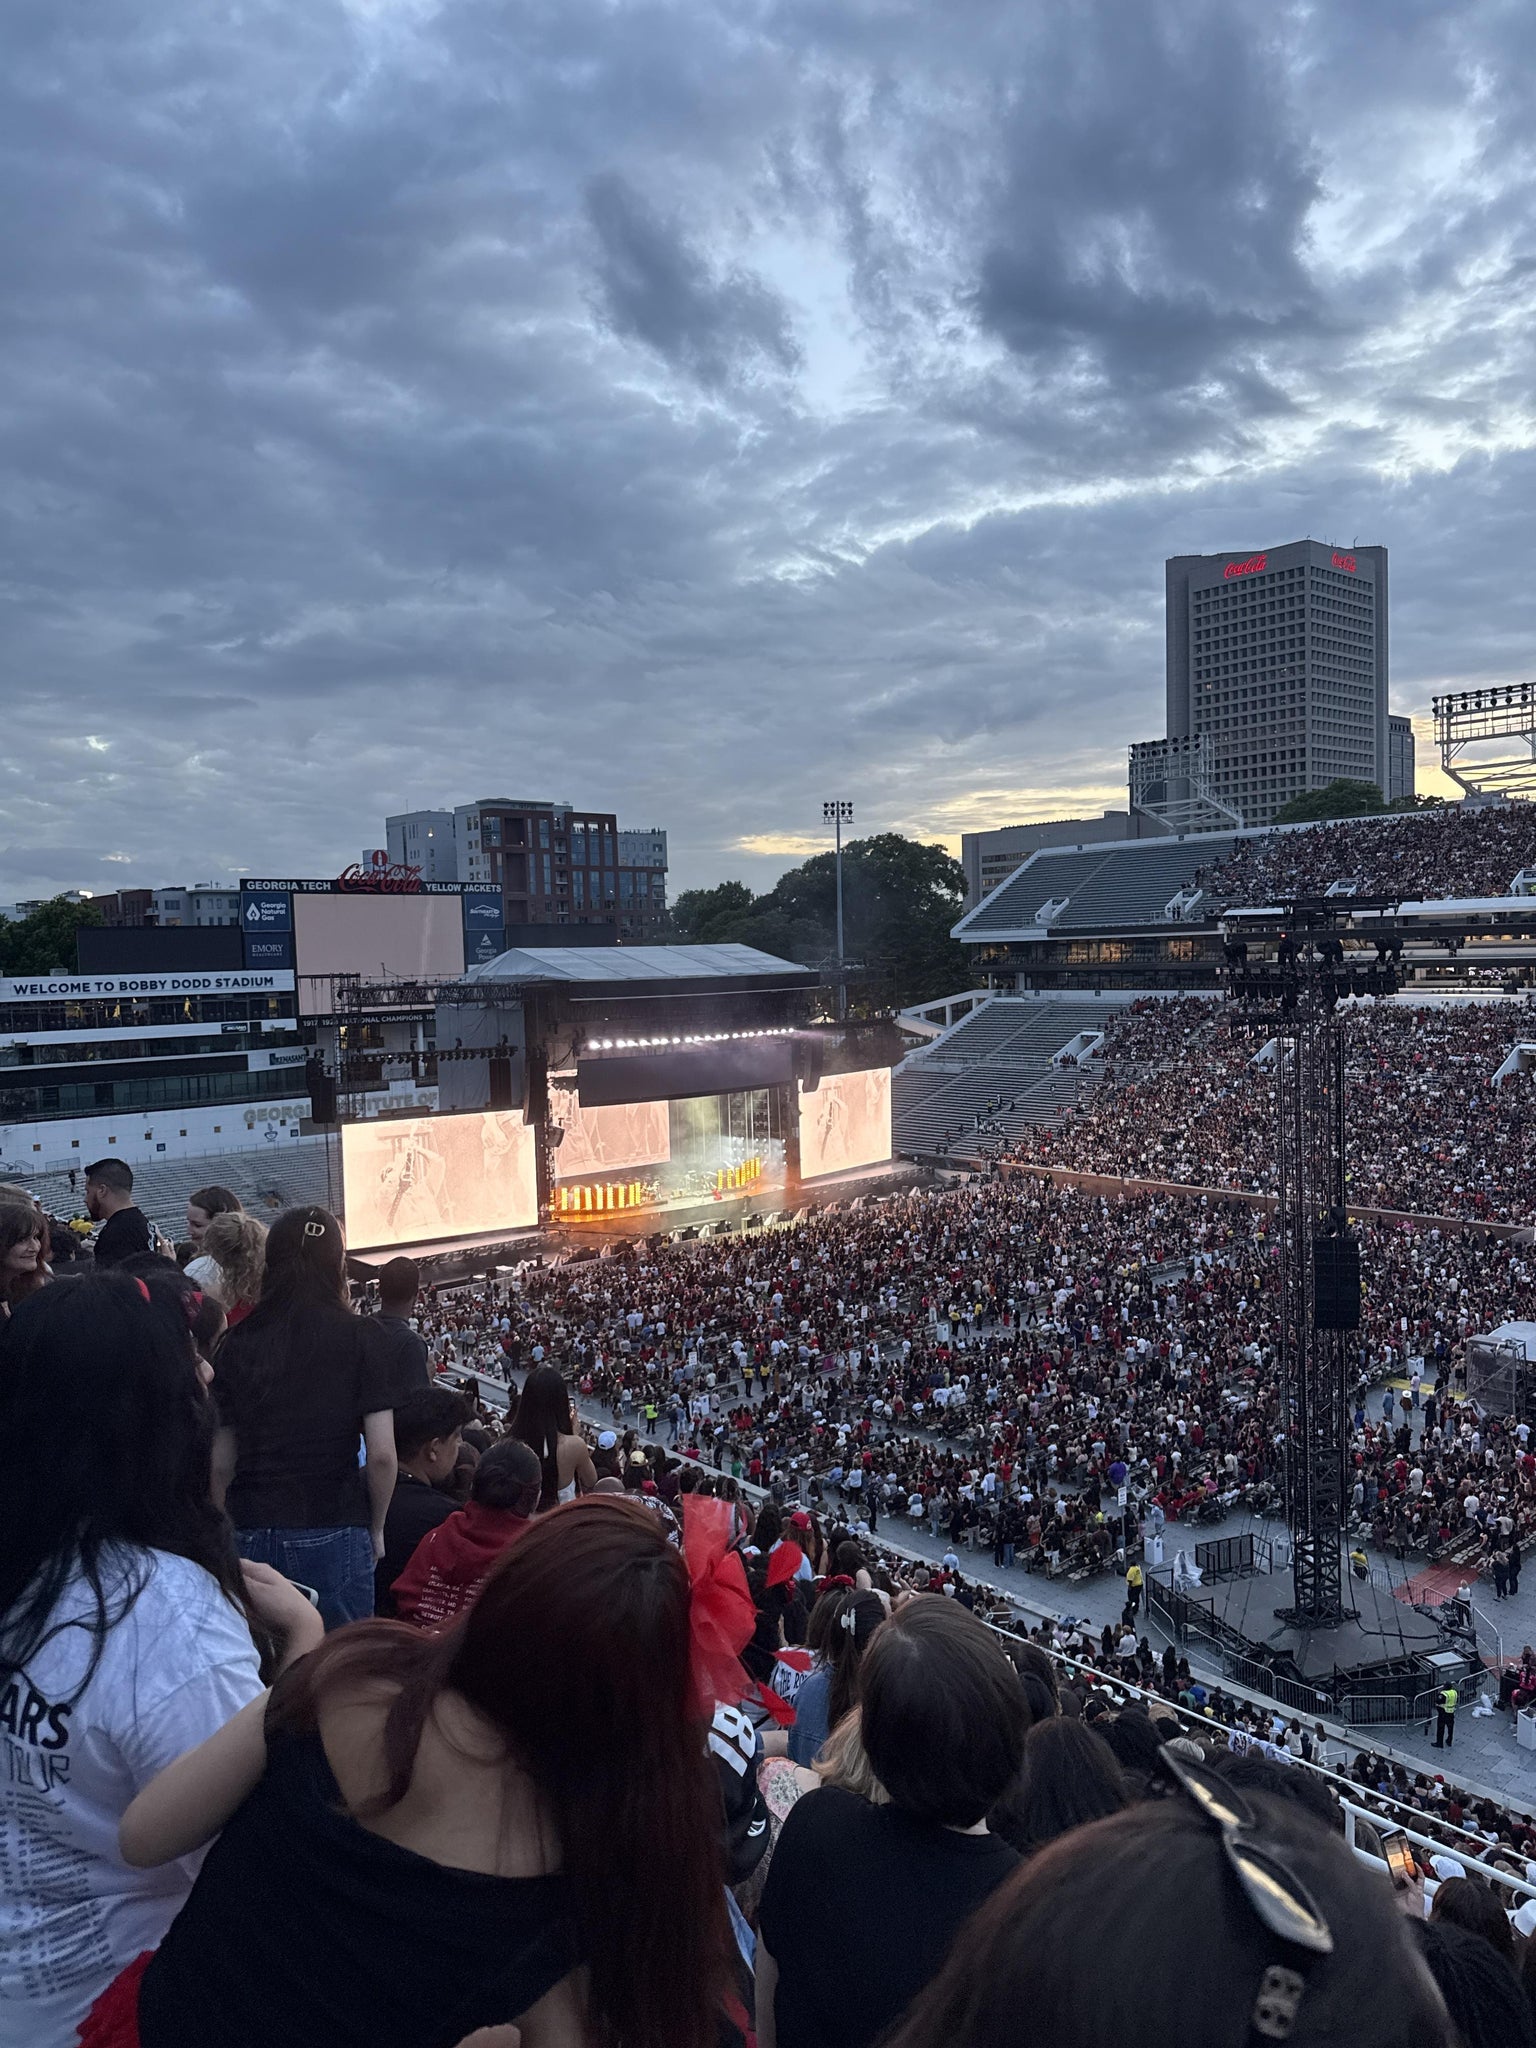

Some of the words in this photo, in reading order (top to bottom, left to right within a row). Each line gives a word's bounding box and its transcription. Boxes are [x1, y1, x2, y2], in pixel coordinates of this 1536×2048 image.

[246, 881, 299, 890] GEORGIA
[301, 881, 331, 890] TECH
[425, 883, 461, 893] YELLOW
[463, 884, 502, 893] JACKETS
[260, 902, 287, 910] Georgia
[251, 944, 284, 953] EMORY
[13, 982, 91, 995] WELCOME
[94, 981, 115, 992] TO
[119, 979, 168, 991] BOBBY
[171, 977, 212, 989] DODD
[215, 975, 274, 988] STADIUM
[303, 1019, 318, 1027] 1917
[381, 1014, 423, 1023] CHAMPIONS
[243, 1103, 312, 1122] GEORGI
[0, 1683, 73, 1750] ARS
